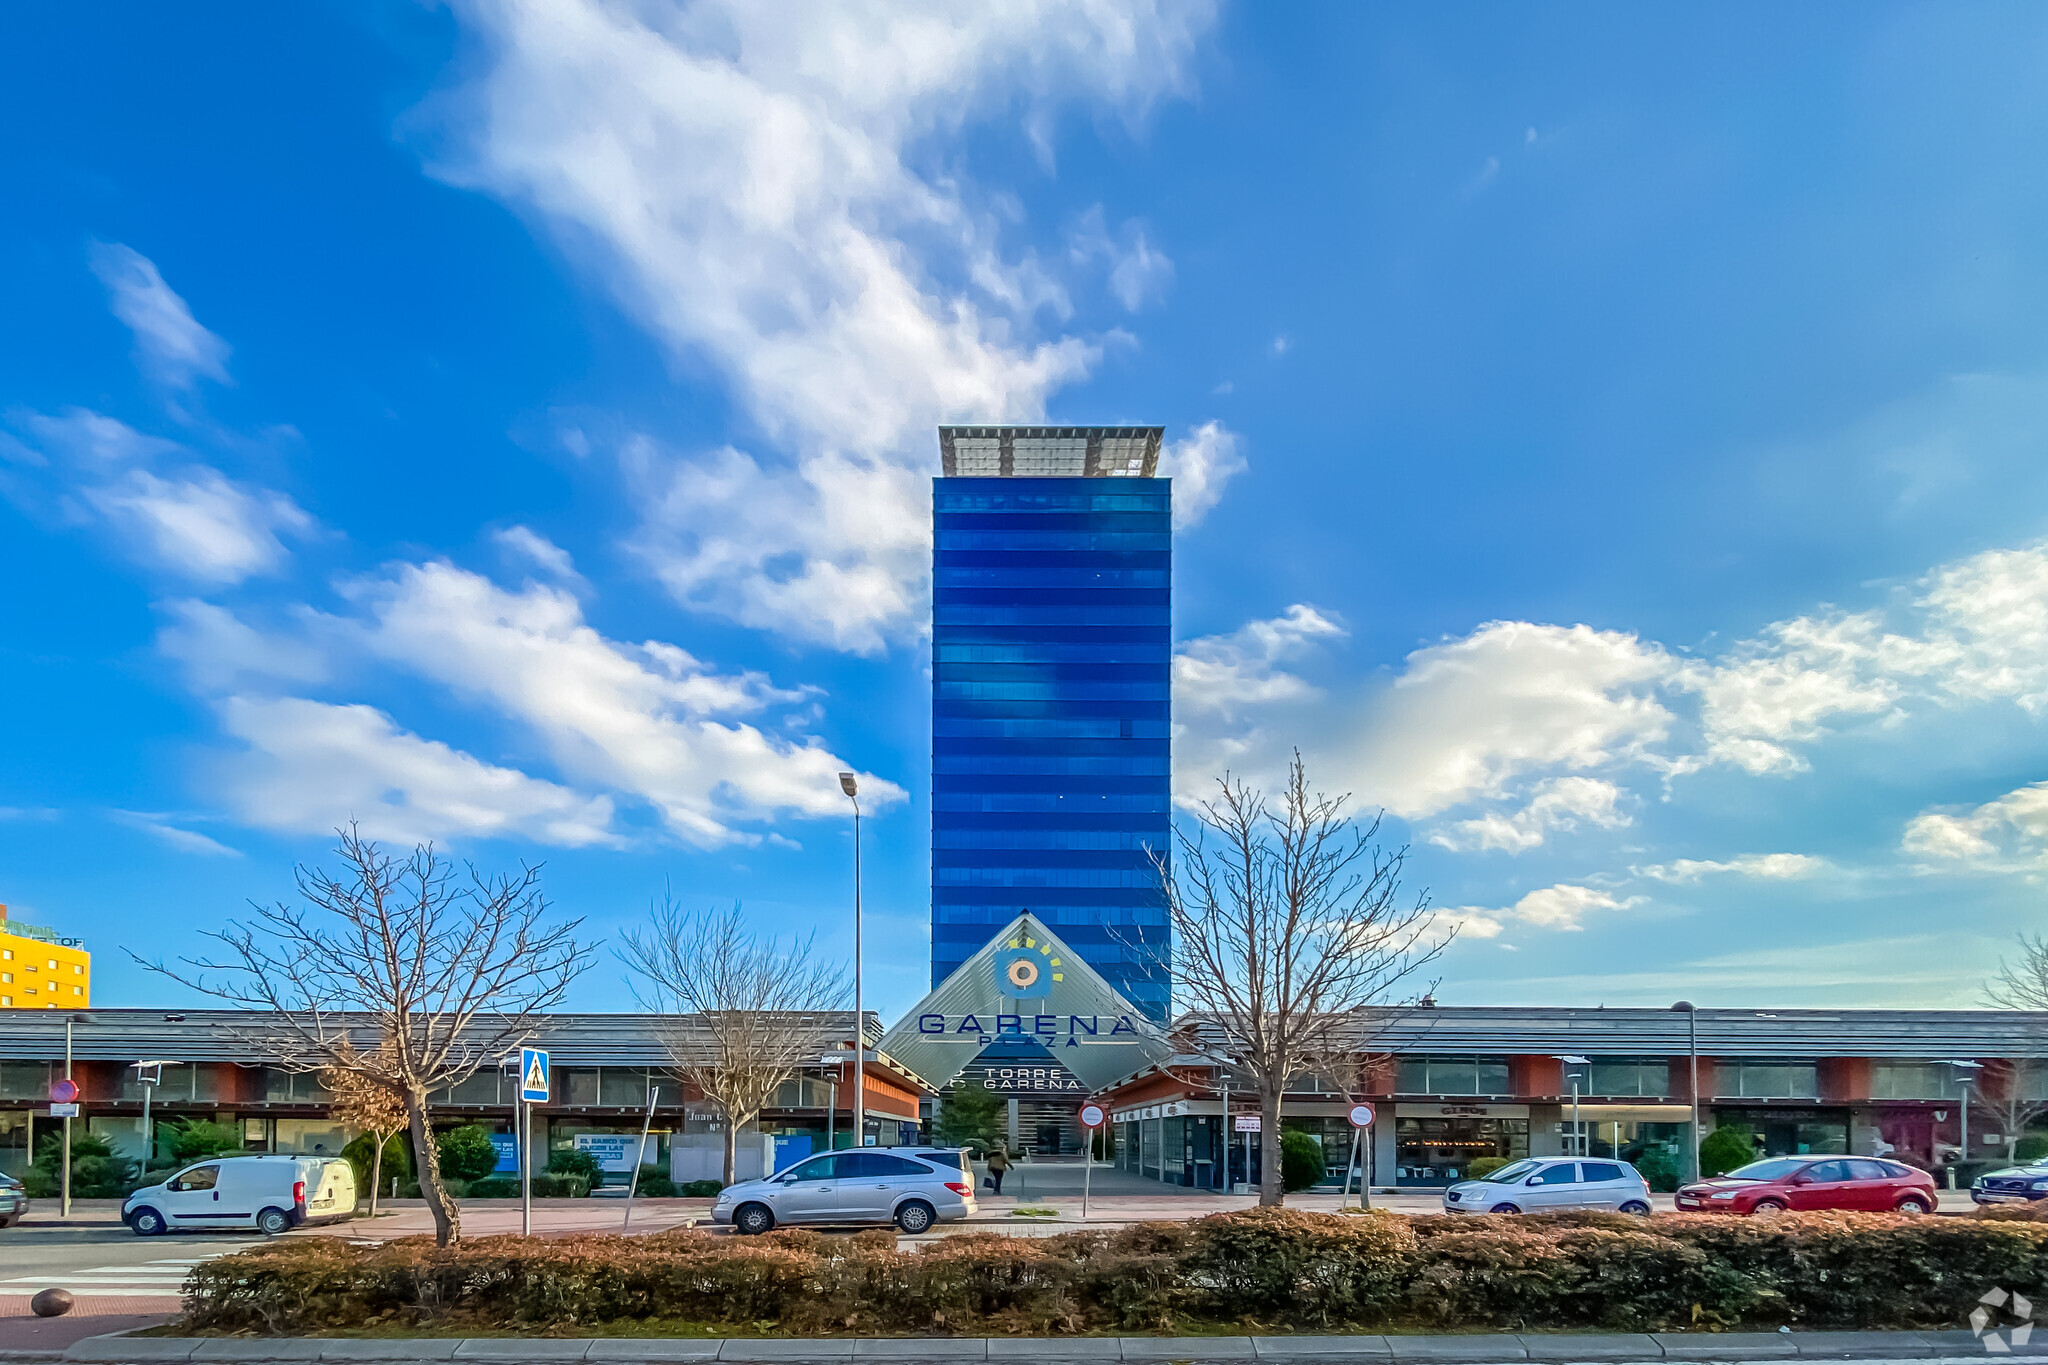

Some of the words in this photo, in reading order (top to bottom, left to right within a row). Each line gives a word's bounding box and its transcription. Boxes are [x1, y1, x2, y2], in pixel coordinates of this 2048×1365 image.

[918, 1013, 1138, 1035] GARENA
[978, 1035, 1079, 1048] PLAZA
[984, 1068, 1061, 1079] TORRE
[983, 1079, 1080, 1090] GARENA
[688, 1111, 712, 1121] Juan
[1441, 1107, 1487, 1115] GINOS
